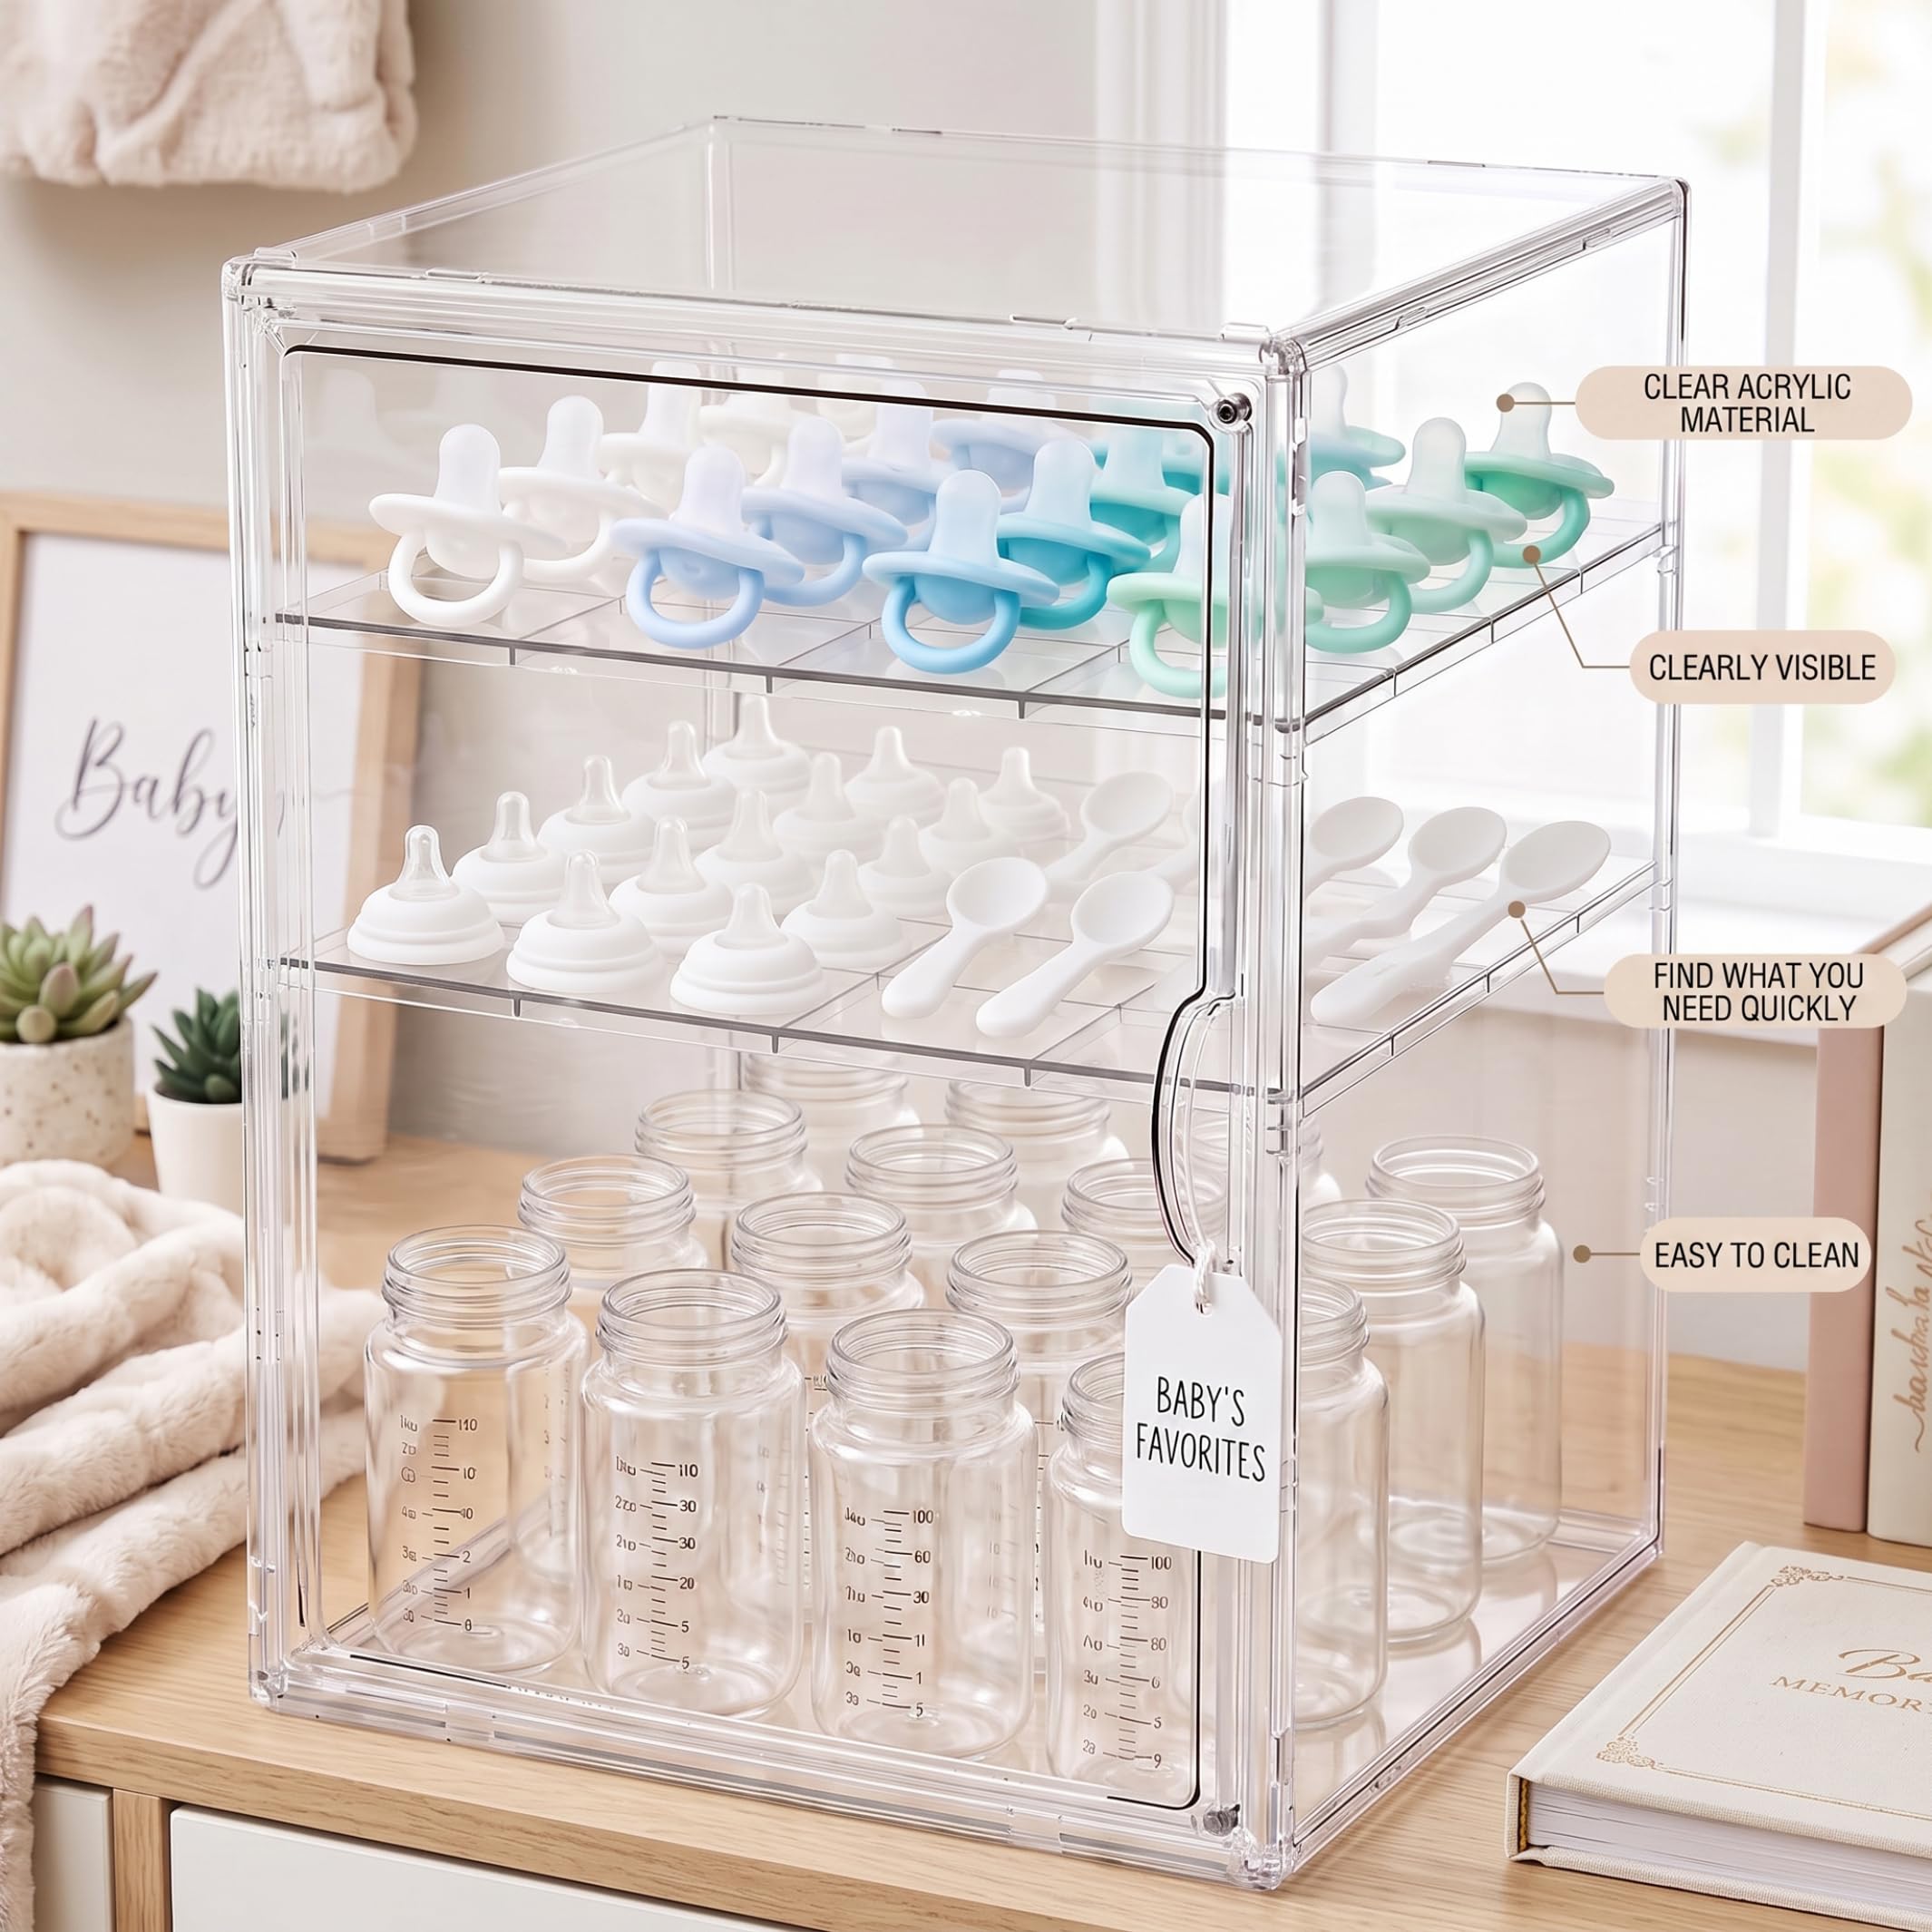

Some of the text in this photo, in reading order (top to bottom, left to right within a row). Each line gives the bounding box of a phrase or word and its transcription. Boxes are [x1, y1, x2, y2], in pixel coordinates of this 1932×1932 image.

[1157, 1376, 1244, 1427] BABY'S
[1137, 1422, 1265, 1482] FAVORITES
[679, 1499, 697, 1513] 30
[912, 1509, 934, 1524] 100
[678, 1537, 696, 1550] 30
[463, 1550, 471, 1563] 2
[914, 1550, 932, 1564] 60
[1151, 1556, 1172, 1570] 100
[679, 1576, 695, 1590] 20
[912, 1590, 930, 1604] 30
[681, 1621, 689, 1633] 5
[1150, 1637, 1167, 1651] 80
[681, 1656, 689, 1669] 5
[1769, 1675, 1932, 1715] MEMOR
[915, 1702, 923, 1717] 5
[1154, 1717, 1162, 1729] 5
[1154, 1753, 1162, 1769] 9
